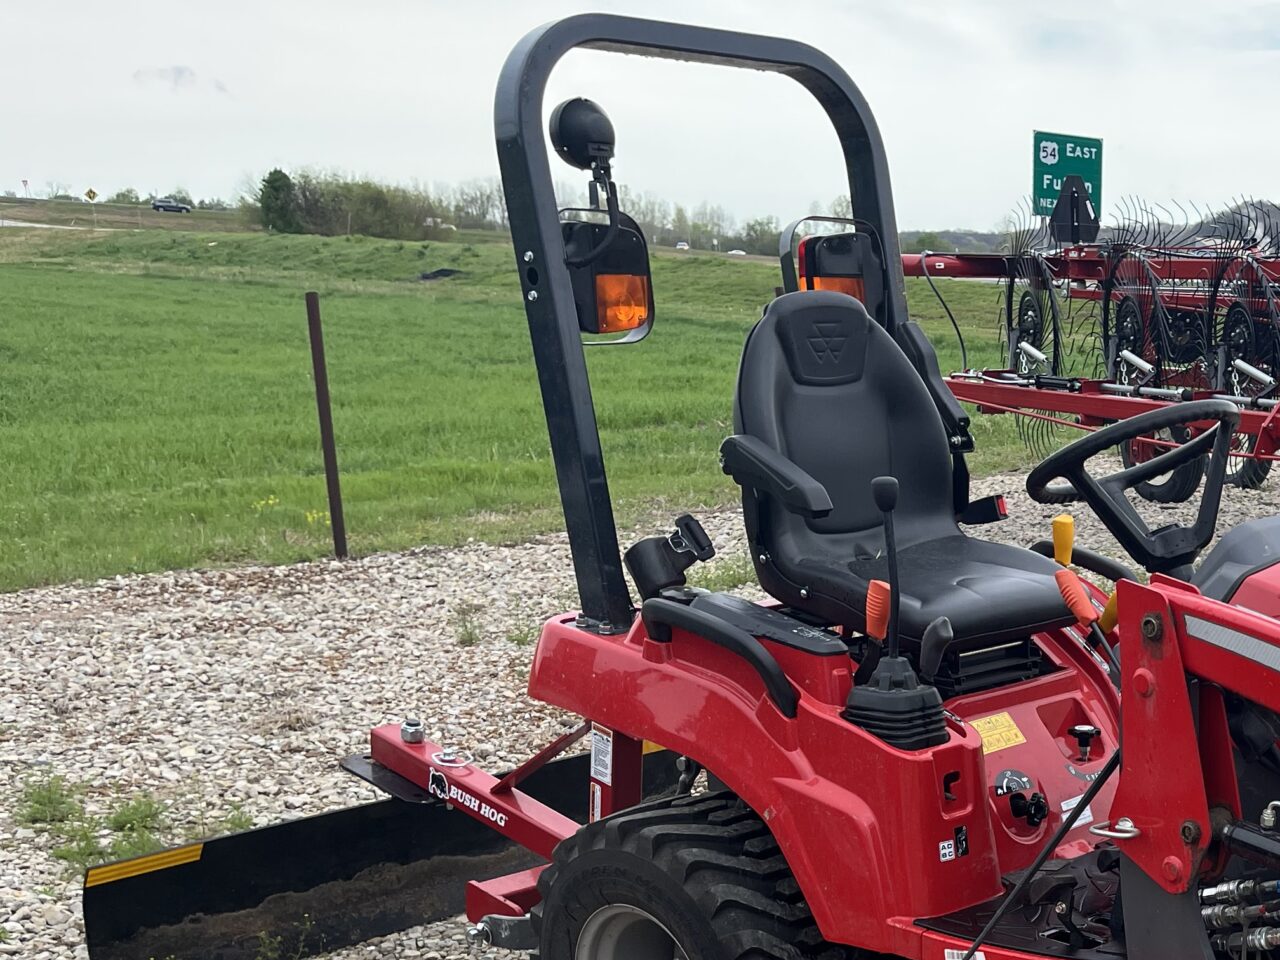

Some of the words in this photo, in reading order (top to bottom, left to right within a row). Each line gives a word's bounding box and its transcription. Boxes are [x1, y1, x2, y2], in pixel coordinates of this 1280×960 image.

[1042, 146, 1057, 160] 54
[1066, 143, 1097, 160] EAST
[450, 784, 479, 812] BUSH
[480, 802, 506, 827] HOG
